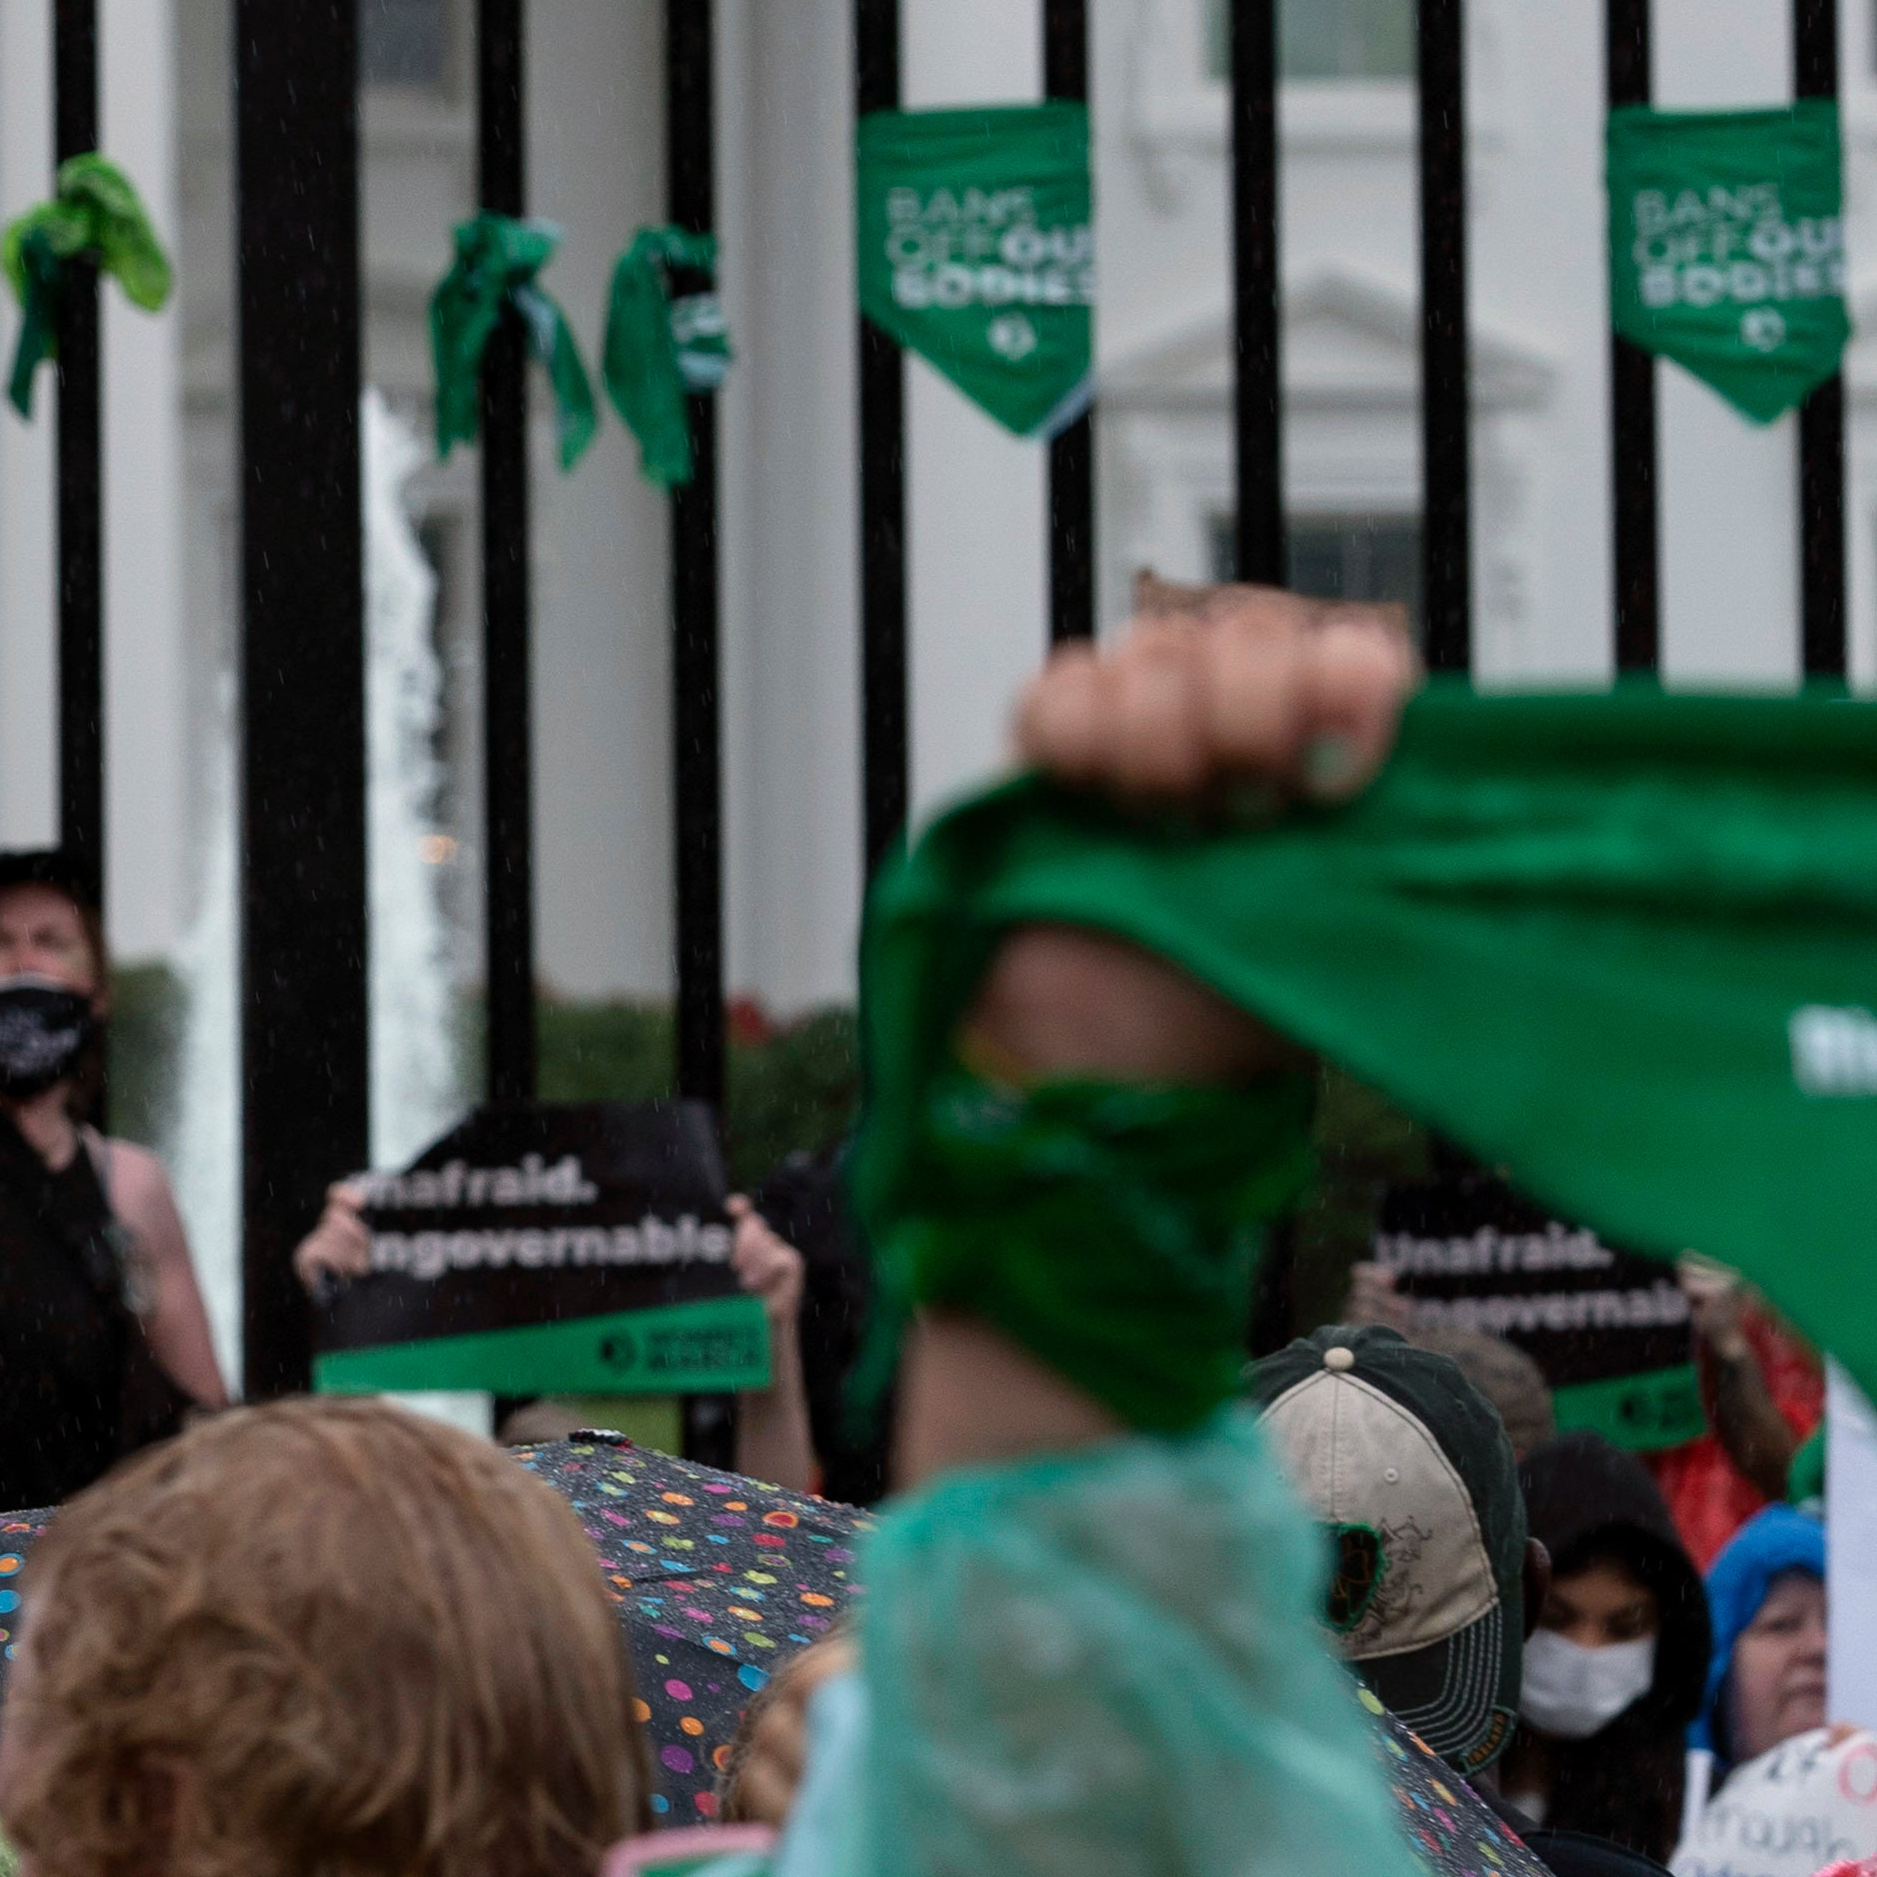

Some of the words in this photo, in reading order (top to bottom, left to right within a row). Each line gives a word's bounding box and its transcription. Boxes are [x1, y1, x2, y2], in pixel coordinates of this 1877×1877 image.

[999, 225, 1093, 266] OU
[1749, 216, 1844, 260] OU
[365, 1152, 600, 1210] nafraid.
[369, 1213, 732, 1281] ngovernable
